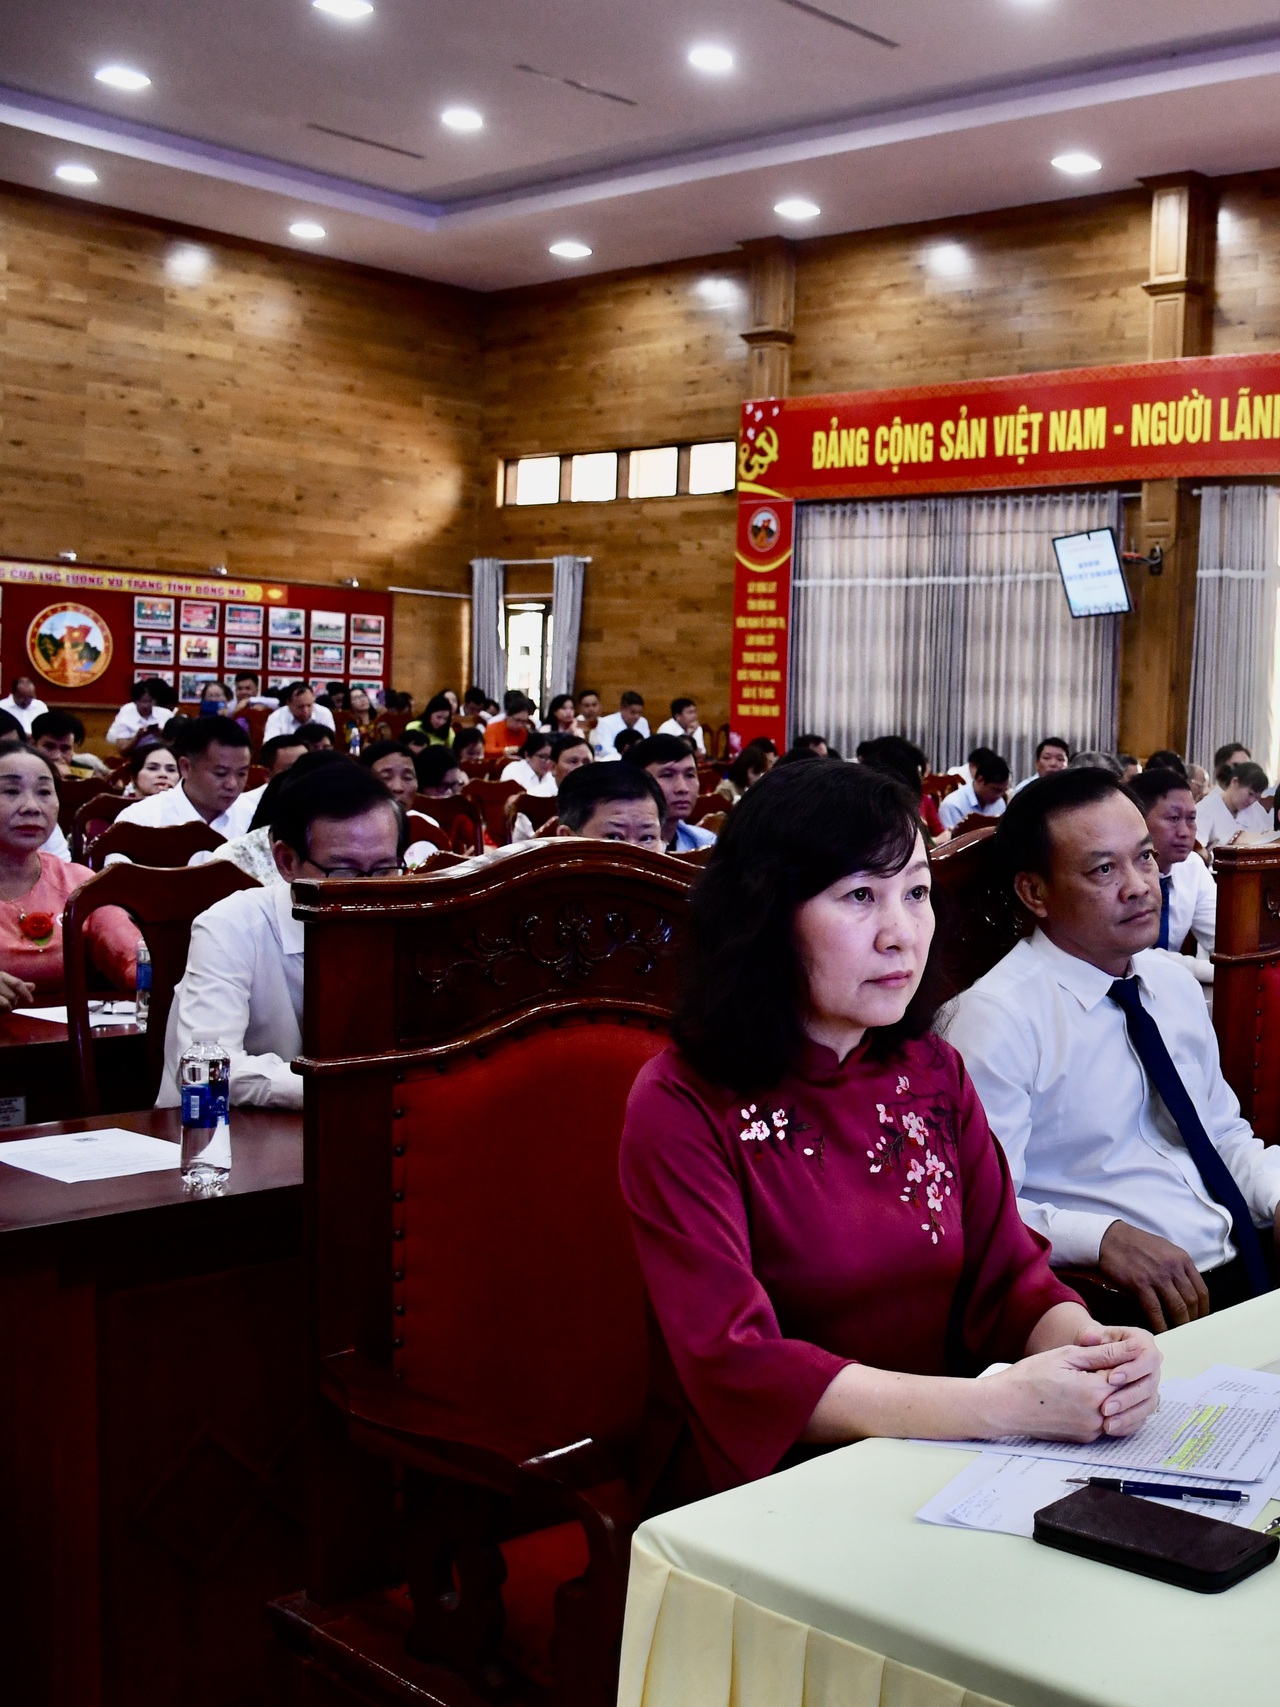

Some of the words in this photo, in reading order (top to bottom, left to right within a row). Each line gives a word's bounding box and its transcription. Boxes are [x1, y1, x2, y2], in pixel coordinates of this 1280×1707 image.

[813, 417, 870, 470] ĐẢNG
[875, 416, 934, 473] CỘNG
[940, 405, 987, 462] SẢN
[993, 405, 1044, 465] VIỆT
[1049, 407, 1107, 453] NAM
[1114, 425, 1125, 436] -
[1131, 389, 1212, 447] NGƯỜI
